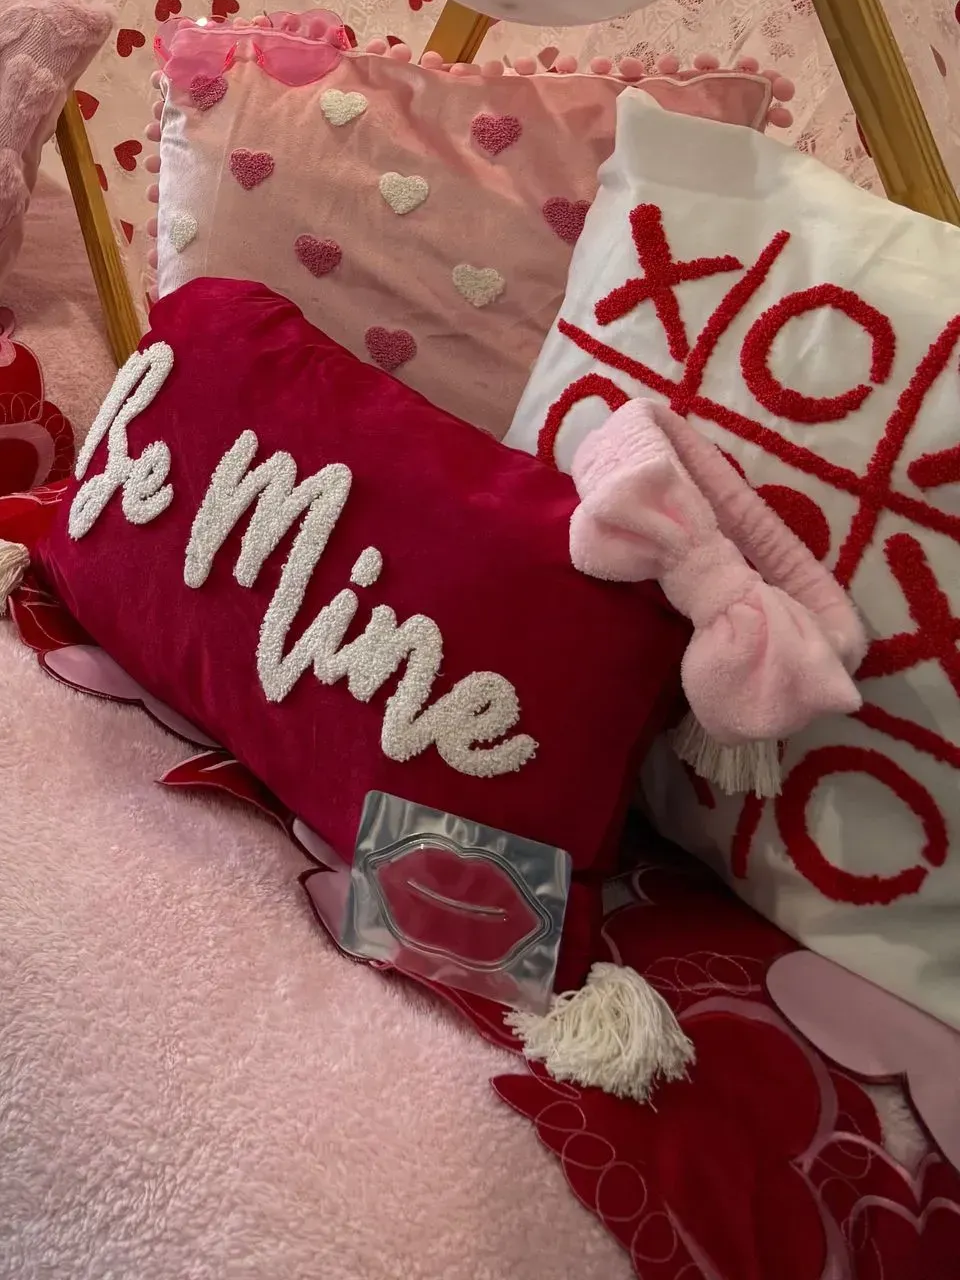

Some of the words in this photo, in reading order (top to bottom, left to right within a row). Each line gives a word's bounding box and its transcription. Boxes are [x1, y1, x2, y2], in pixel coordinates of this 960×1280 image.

[595, 203, 744, 363] X
[740, 282, 896, 423] O
[68, 341, 174, 540] Be
[184, 429, 540, 778] Mine
